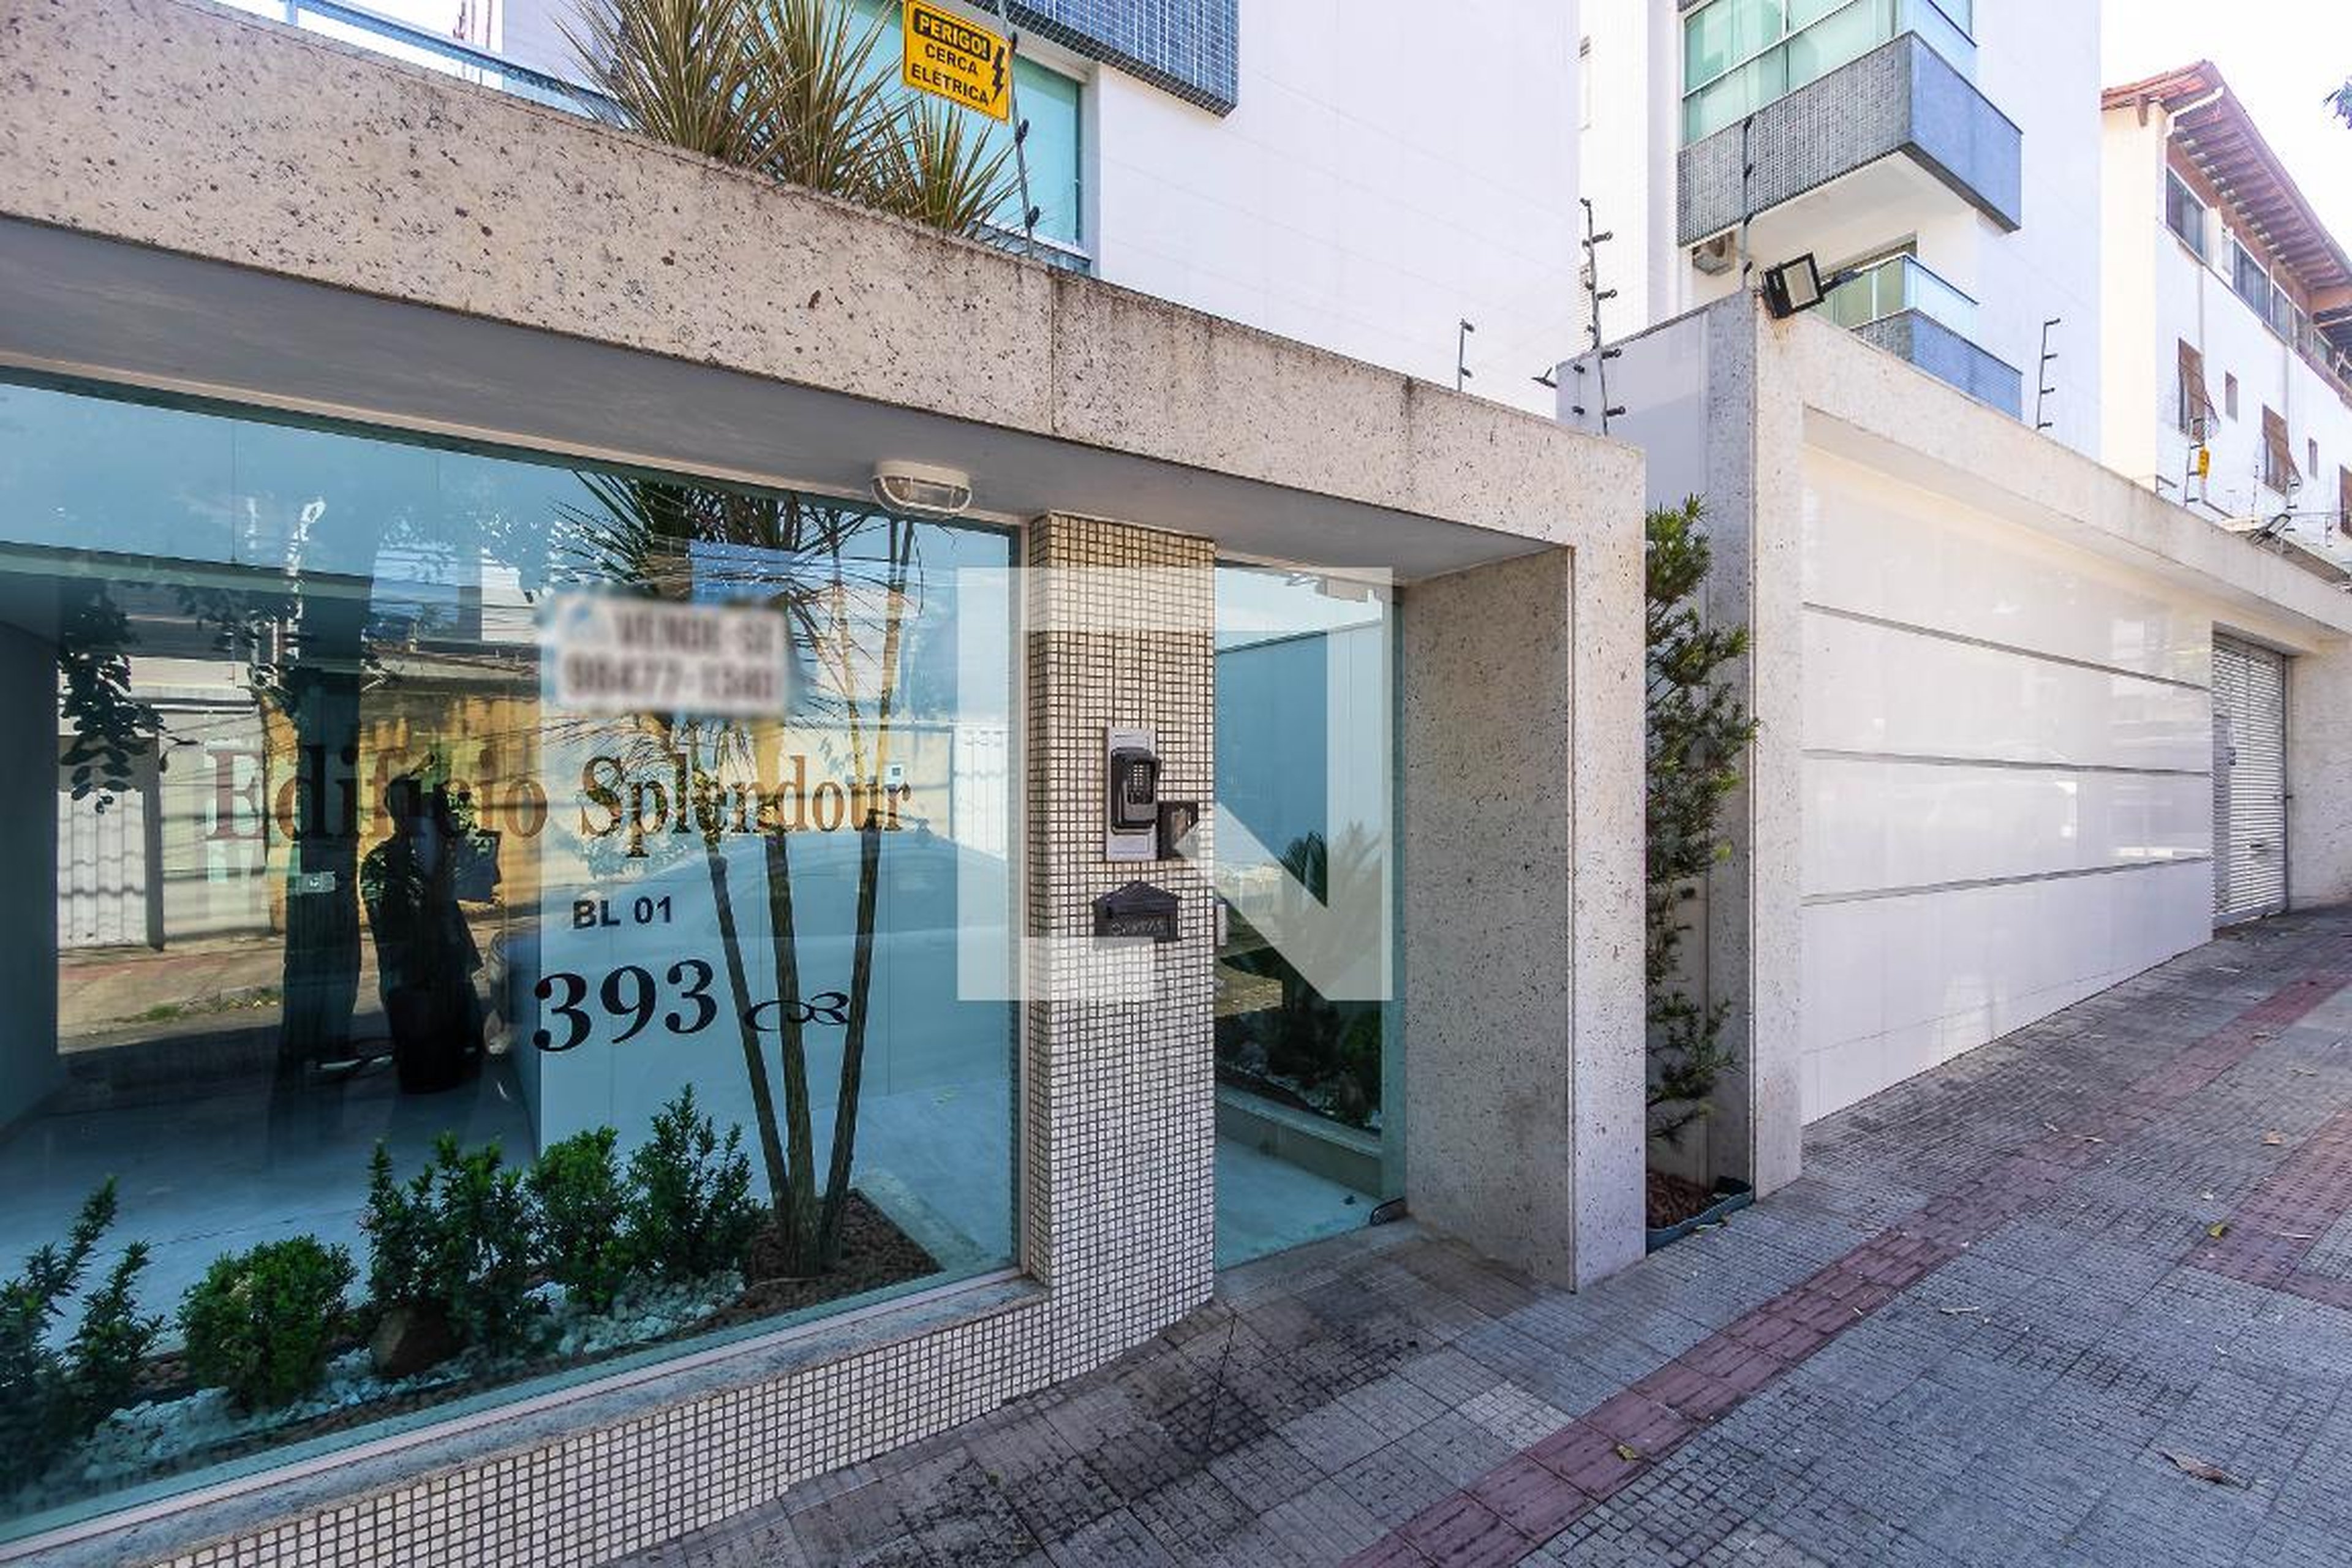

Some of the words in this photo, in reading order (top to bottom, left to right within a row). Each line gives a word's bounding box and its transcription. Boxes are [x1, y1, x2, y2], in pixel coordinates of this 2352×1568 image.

[919, 15, 987, 58] PERIGO!
[925, 43, 979, 77] CERCA
[573, 899, 620, 929] BL
[634, 895, 672, 924] 01
[533, 958, 718, 1052] 393
